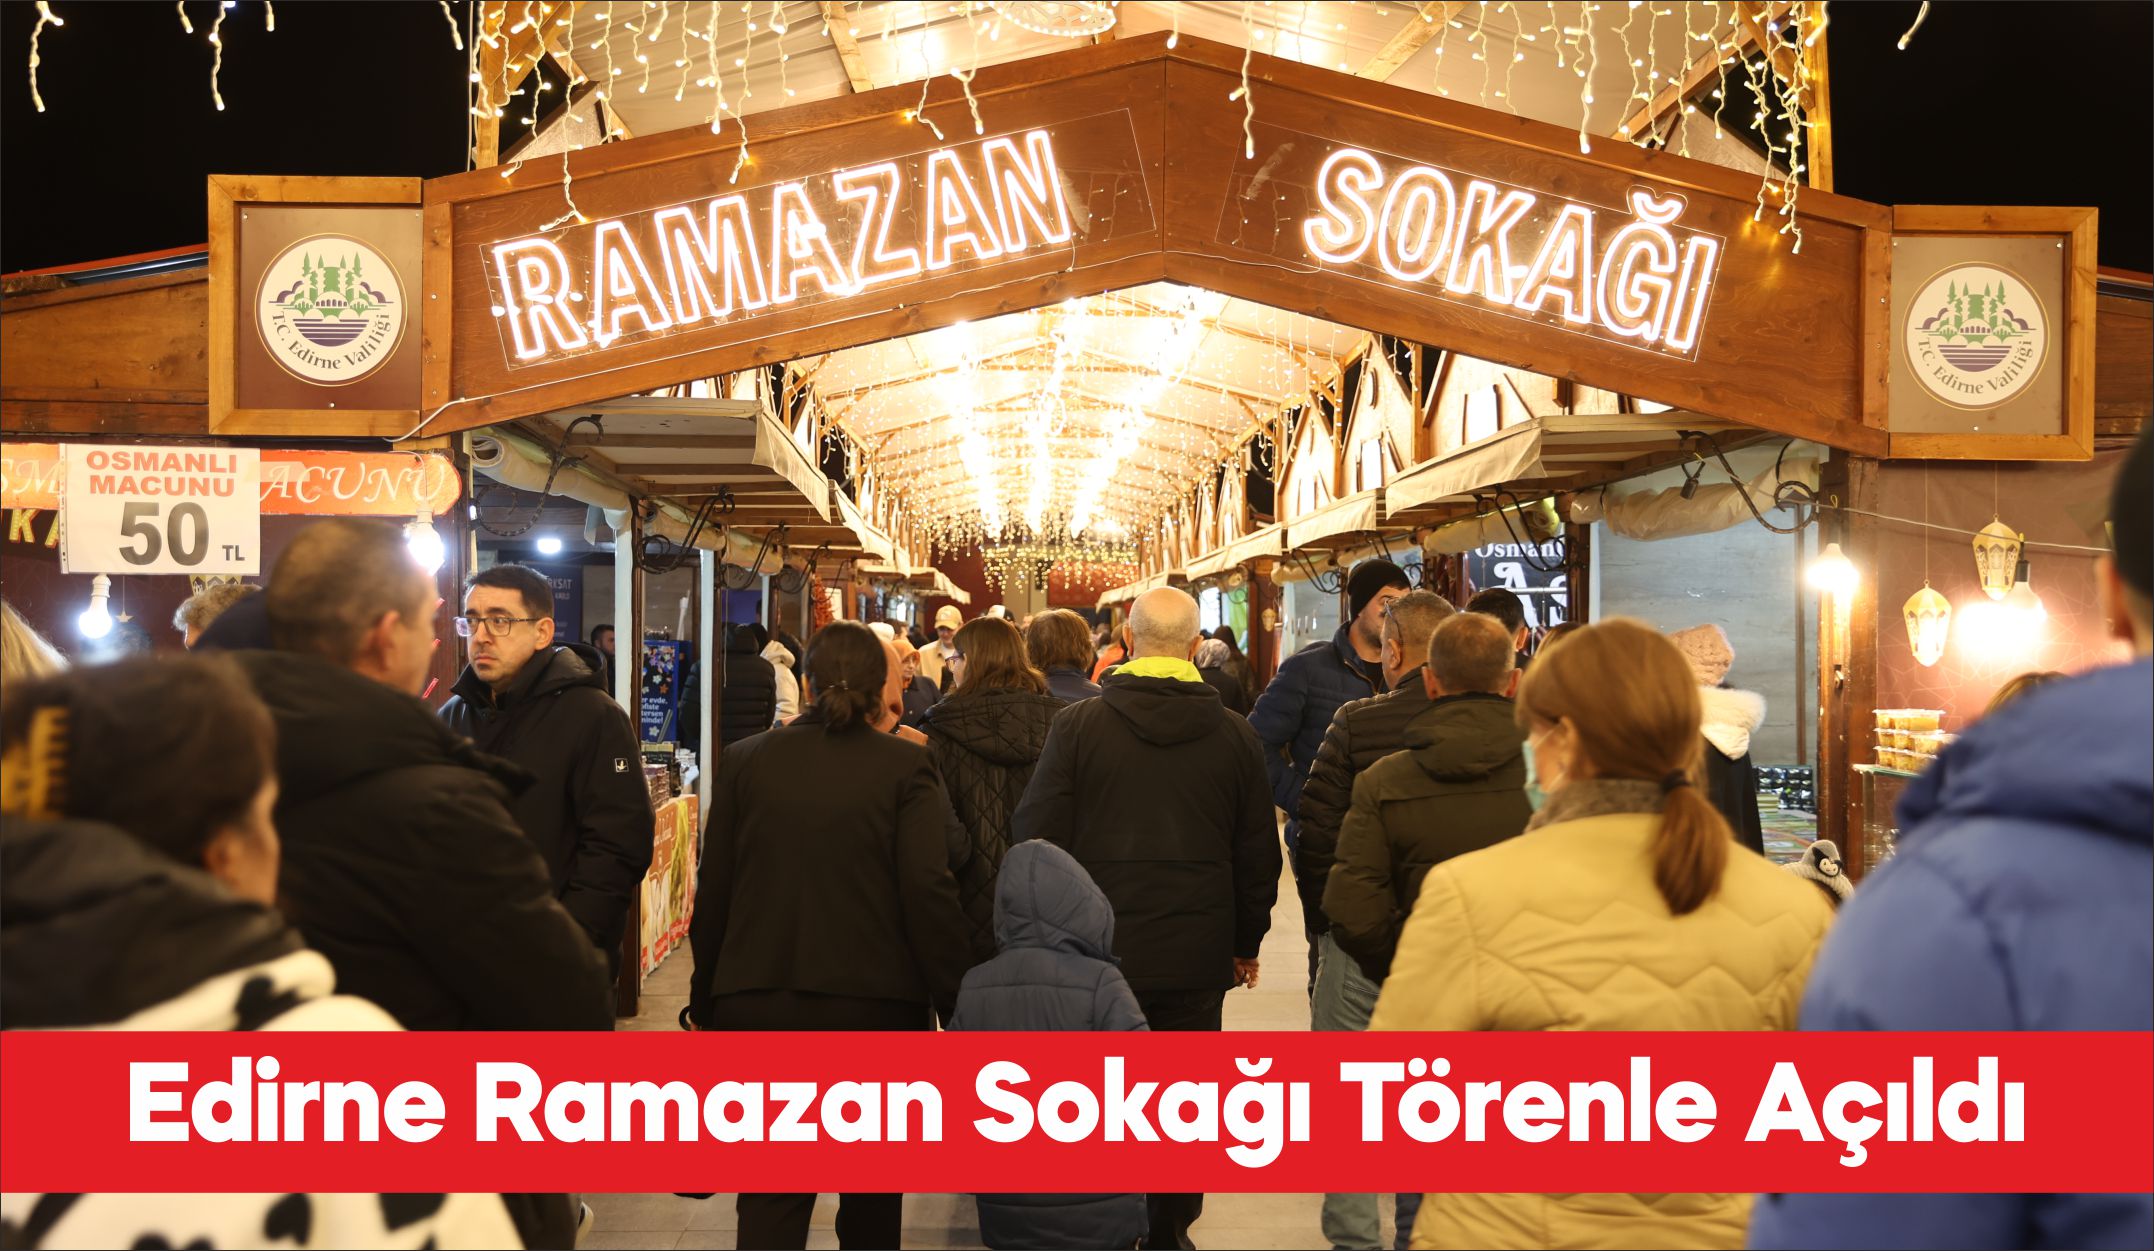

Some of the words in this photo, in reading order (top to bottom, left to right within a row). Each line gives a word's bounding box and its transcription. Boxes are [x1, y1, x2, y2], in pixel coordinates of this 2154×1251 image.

[492, 129, 1073, 359] RAMAZAN
[1303, 147, 1718, 350] SOKAĞI
[272, 310, 291, 341] T.C.
[288, 340, 342, 370] Edirne
[344, 314, 392, 367] Valiliği
[1918, 337, 1936, 367] T.C.
[1932, 366, 1984, 395] Edirne
[1986, 340, 2033, 392] Valiliği
[86, 450, 237, 474] OSMANLI
[89, 475, 235, 497] MACUNU
[119, 501, 210, 567] 50
[222, 545, 245, 562] TL
